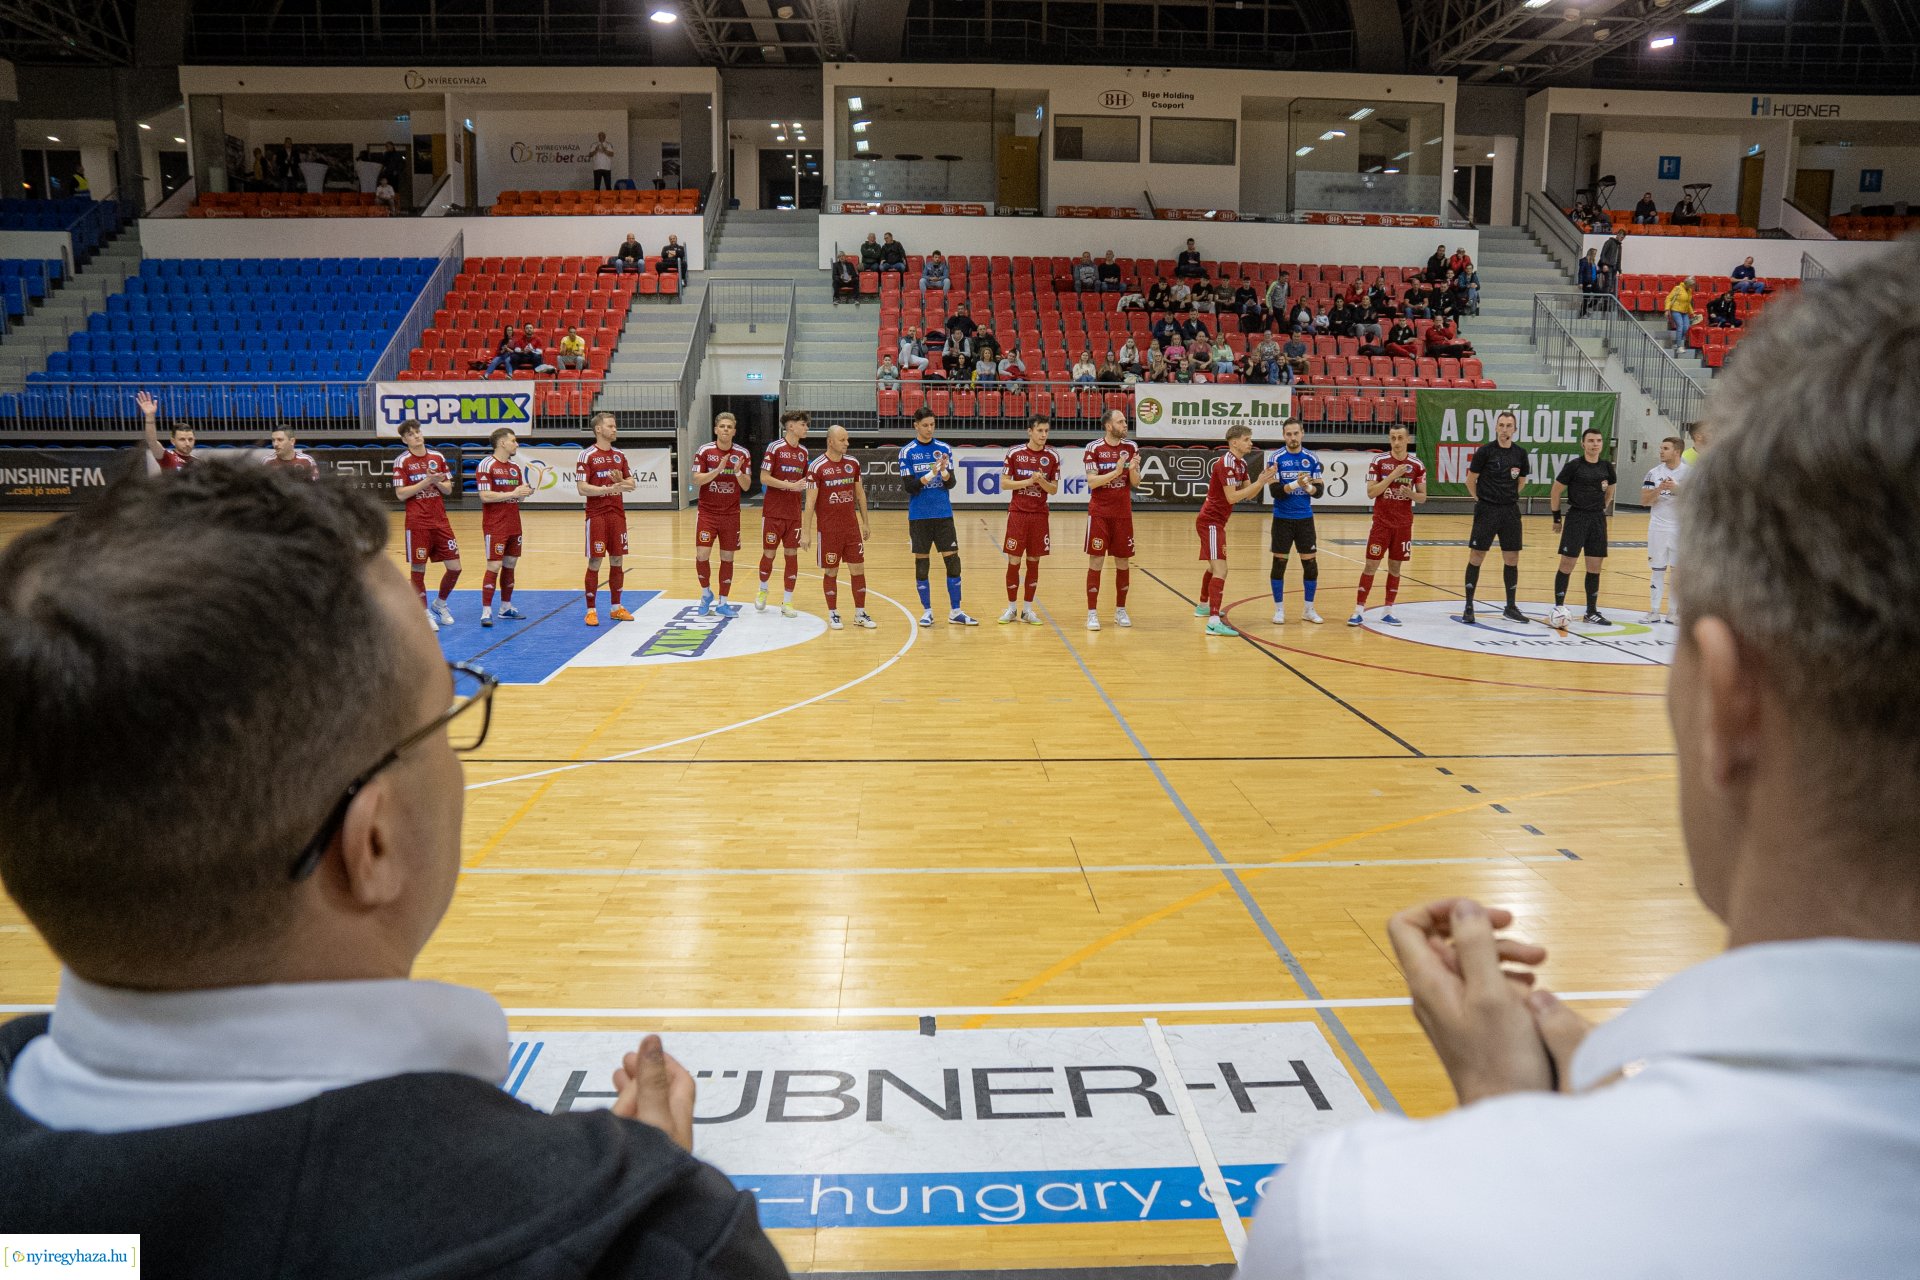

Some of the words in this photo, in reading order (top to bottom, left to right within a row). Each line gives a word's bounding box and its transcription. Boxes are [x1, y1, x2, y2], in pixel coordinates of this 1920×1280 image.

[428, 77, 487, 85] NYÍREGYHÁZA
[1105, 94, 1126, 106] BH
[1142, 91, 1160, 99] Bige
[1163, 92, 1194, 100] Holding
[1152, 101, 1184, 109] Csoport
[1773, 103, 1840, 117] HÜBNER
[536, 152, 574, 163] Többet
[1172, 399, 1289, 418] mlsz.hu
[1172, 418, 1200, 426] Magyar
[1248, 418, 1284, 426] Szövetsé
[1439, 408, 1459, 442] A
[1437, 446, 1481, 484] NE
[958, 460, 1004, 495] Ta
[34, 486, 44, 497] jó
[46, 486, 71, 495] zene!
[1136, 481, 1210, 497] STUD
[1044, 534, 1050, 546] 6
[858, 542, 864, 554] 2
[1401, 541, 1412, 552] 10
